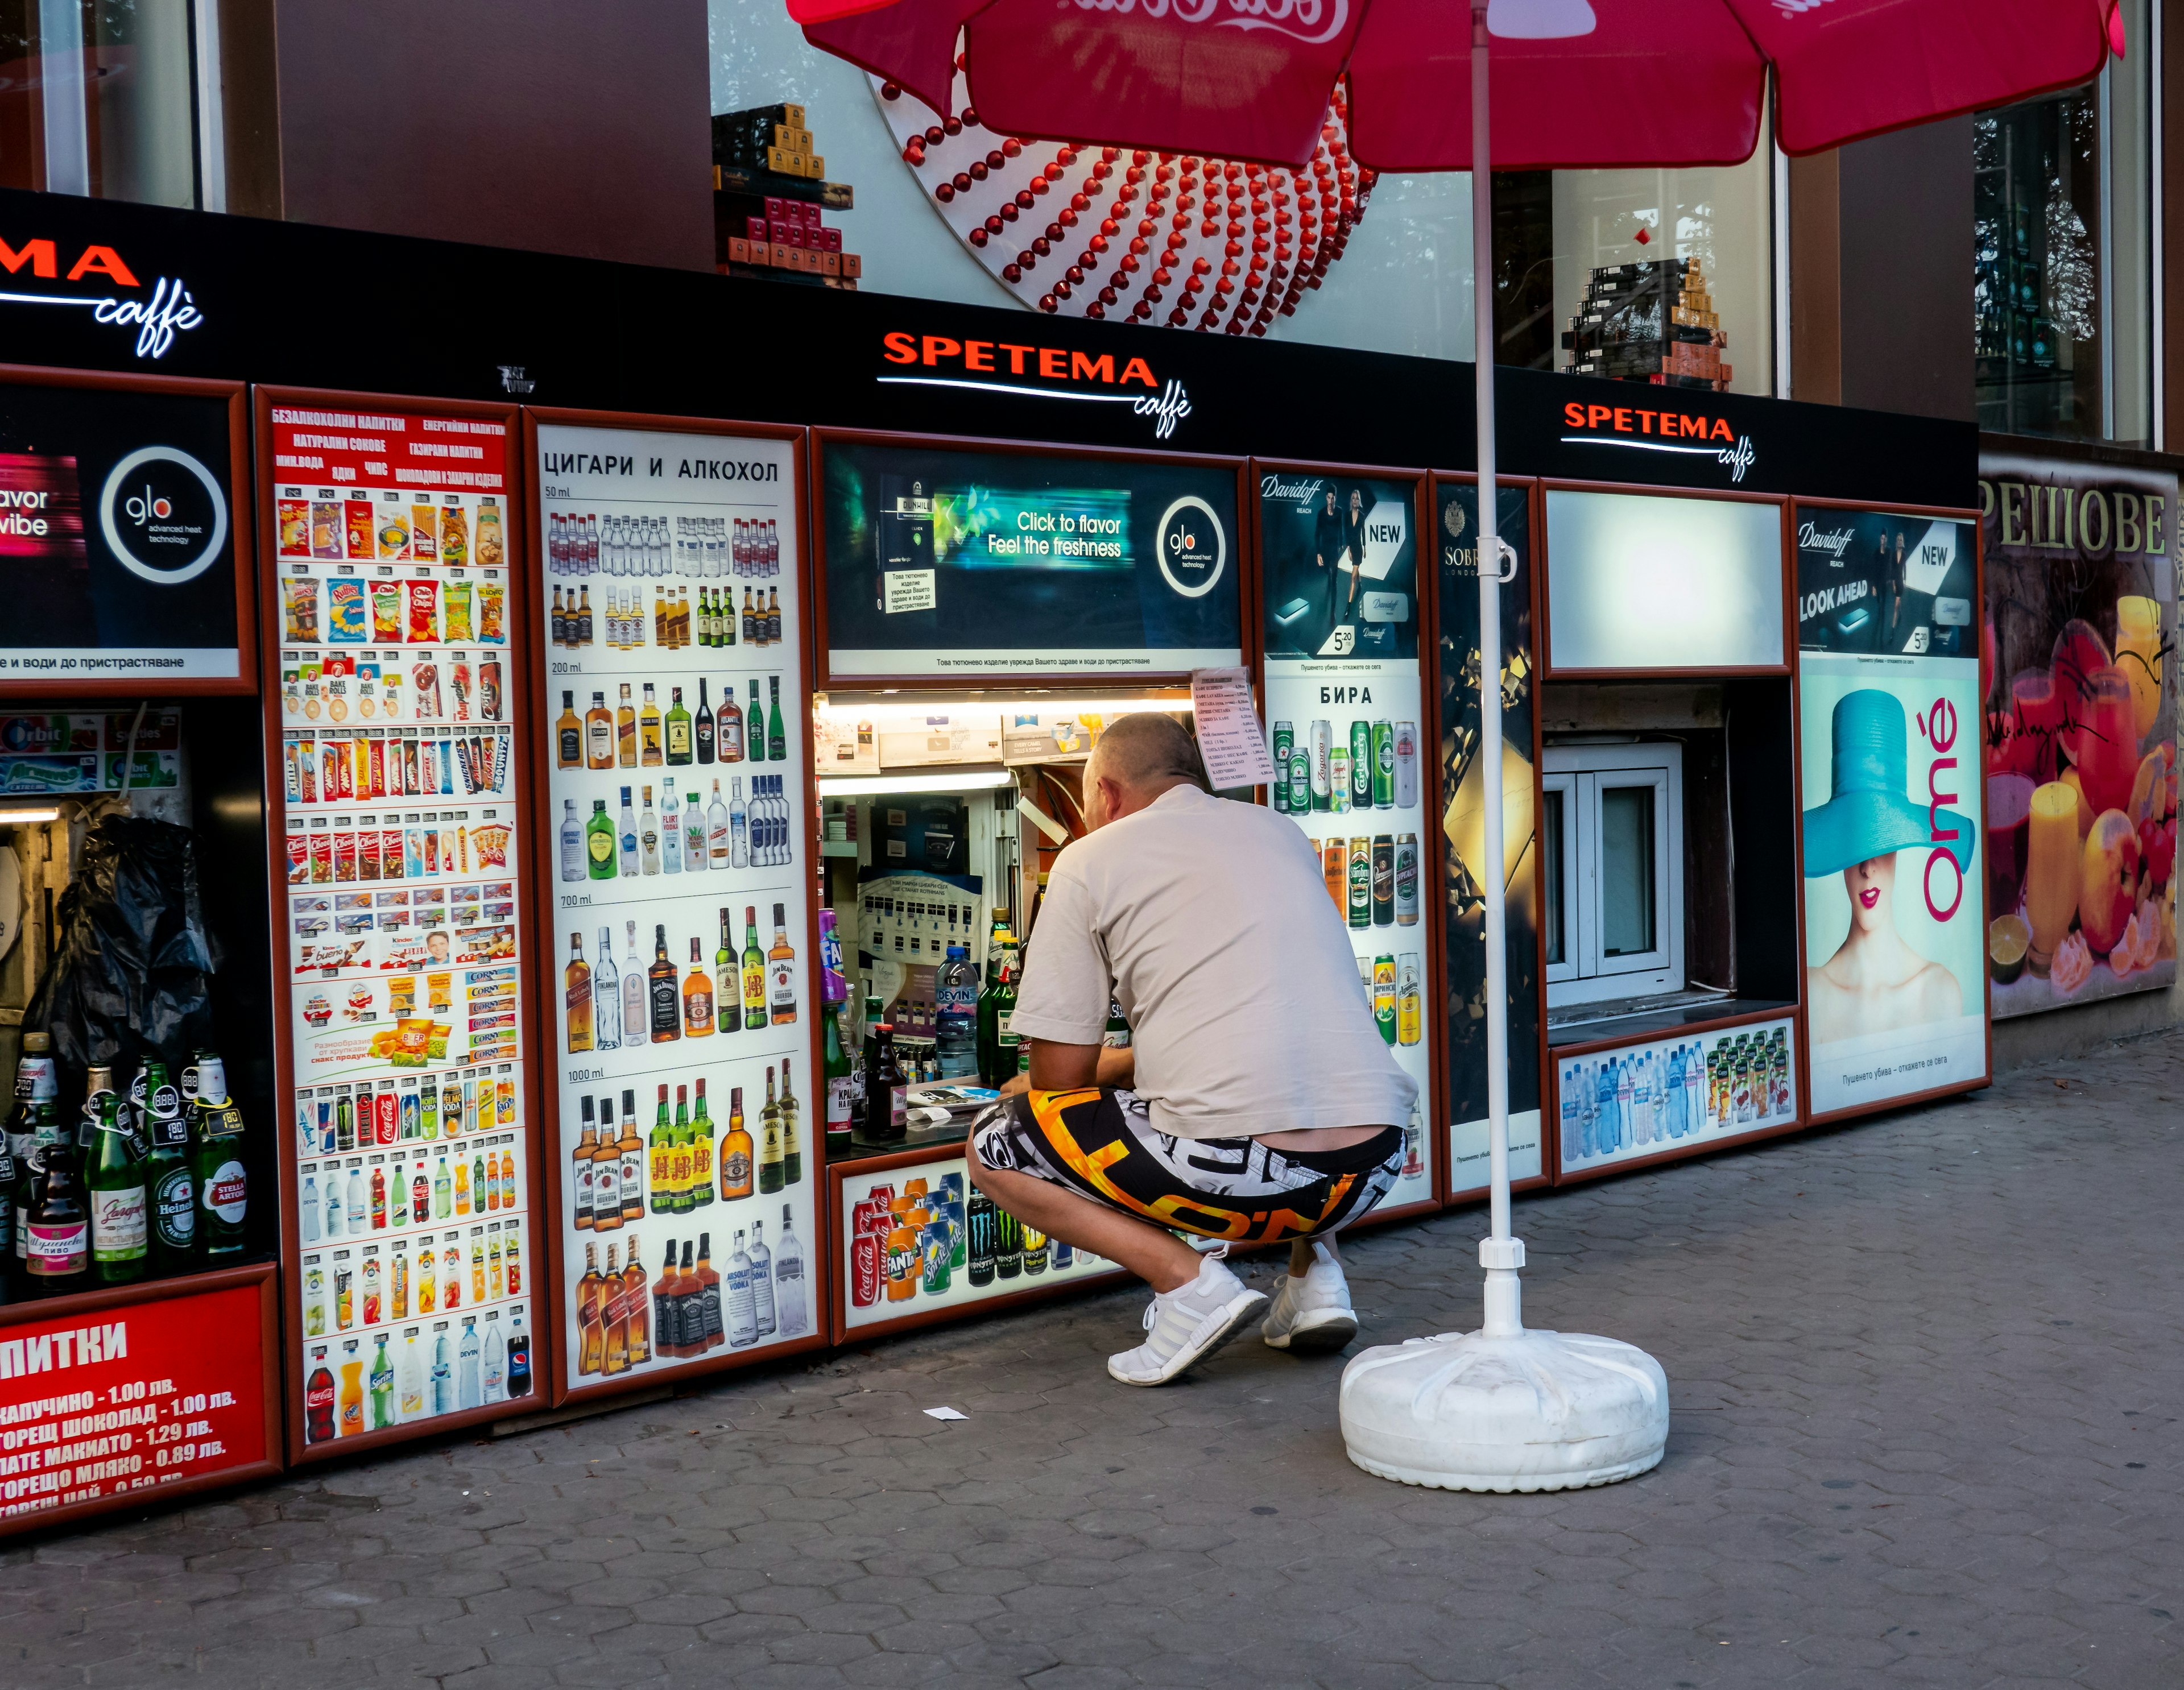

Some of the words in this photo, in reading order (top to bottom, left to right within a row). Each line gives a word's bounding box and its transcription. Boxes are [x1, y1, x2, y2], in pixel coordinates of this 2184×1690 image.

[94, 277, 203, 358] caffè
[883, 332, 1157, 387] SPETEMA
[1135, 379, 1192, 438] caffè
[272, 409, 356, 428] БЕЗАЛКОХОЛНИ
[357, 415, 406, 432] НАПИТКИ
[423, 420, 469, 433] ЕНЕРГИЙНИ
[470, 425, 506, 436] НАПИТКИ
[1565, 402, 1735, 442] SPETEMA
[293, 434, 348, 450] НАТУРАЛНИ
[349, 437, 386, 453] СОКОВЕ
[409, 442, 448, 458] ГАЗИРАНИ
[449, 446, 483, 459] НАПИТКИ
[276, 455, 324, 469] МИН.ВОДА
[545, 453, 632, 477] ЦИГАРИ
[650, 458, 662, 477] И
[678, 459, 778, 482] АЛКОХОЛ
[1718, 435, 1756, 483] caffè
[332, 466, 356, 482] ЯДКИ
[365, 461, 388, 477] ЧИПС
[395, 468, 440, 486] ШОКОЛАДОВИ
[441, 471, 446, 484] И
[446, 470, 474, 487] ЗАХАРНИ
[474, 473, 502, 488] ИЗДЕЛИЯ
[545, 486, 556, 497] 50
[558, 487, 570, 498] ml
[1261, 474, 1323, 505] Davidoff
[126, 484, 172, 526] glo
[903, 501, 930, 510] DUNHILL
[148, 524, 183, 533] advanced
[185, 525, 202, 534] heat
[1017, 512, 1056, 532] Click
[1059, 516, 1075, 533] to
[1078, 513, 1120, 534] flavor
[149, 535, 189, 545] technology
[1170, 524, 1195, 555] glo
[1369, 524, 1401, 544] NEW
[1798, 521, 1855, 558] Davidoff
[988, 535, 1020, 554] Feel
[1024, 536, 1049, 555] the
[1053, 537, 1120, 558] freshness
[1922, 545, 1947, 567] NEW
[333, 583, 358, 602] Ruffles
[1800, 590, 1835, 623] LOOK
[1836, 579, 1868, 607] AHEAD
[892, 602, 930, 610] пристрастяване
[1373, 598, 1399, 612] Davidoff
[1363, 627, 1387, 641] Davidoff
[11, 658, 19, 668] и
[23, 658, 57, 671] води
[60, 658, 77, 672] до
[80, 657, 185, 670] пристрастяване
[552, 662, 568, 673] 200
[570, 662, 581, 673] ml
[1321, 686, 1372, 704] БИРА
[592, 728, 608, 736] SAVOY
[1290, 776, 1309, 785] Heineken
[1916, 697, 1963, 922] Omé
[663, 814, 679, 824] FLIRT
[561, 895, 578, 906] 700
[580, 894, 592, 905] ml
[316, 948, 344, 961] bueno
[471, 969, 499, 980] CORNY
[597, 980, 618, 991] FINLANDIA
[775, 991, 793, 1000] BOURBON
[938, 989, 971, 1002] DEVIN
[315, 1038, 371, 1049] Разнообразие
[403, 1033, 424, 1042] BEER
[330, 1046, 367, 1056] хрупкави
[568, 1068, 590, 1082] 1000
[592, 1067, 604, 1079] ml
[1843, 1071, 1872, 1086] Пушенето
[1874, 1067, 1892, 1080] убива
[1898, 1061, 1925, 1073] откажете
[1926, 1058, 1933, 1067] се
[1934, 1055, 1947, 1065] сега
[218, 1181, 245, 1194] STELLA
[218, 1188, 245, 1201] ARTOIS
[887, 1250, 915, 1274] FANTA
[969, 1258, 995, 1270] MONSTER
[0, 1321, 127, 1380] ПИТКИ
[371, 1371, 393, 1389] Sprite
[107, 1381, 146, 1405] 1.00
[148, 1378, 177, 1397] лв.
[62, 1403, 158, 1439] ШОКОЛАД
[171, 1393, 206, 1416] 1.00
[209, 1391, 237, 1409] лв.
[44, 1432, 132, 1467] МАКИАТО
[146, 1423, 182, 1446] 1.29
[185, 1420, 213, 1439] лв.
[76, 1453, 142, 1485] МЛЯКО
[156, 1443, 195, 1468] 0.89
[197, 1440, 226, 1460] лв.
